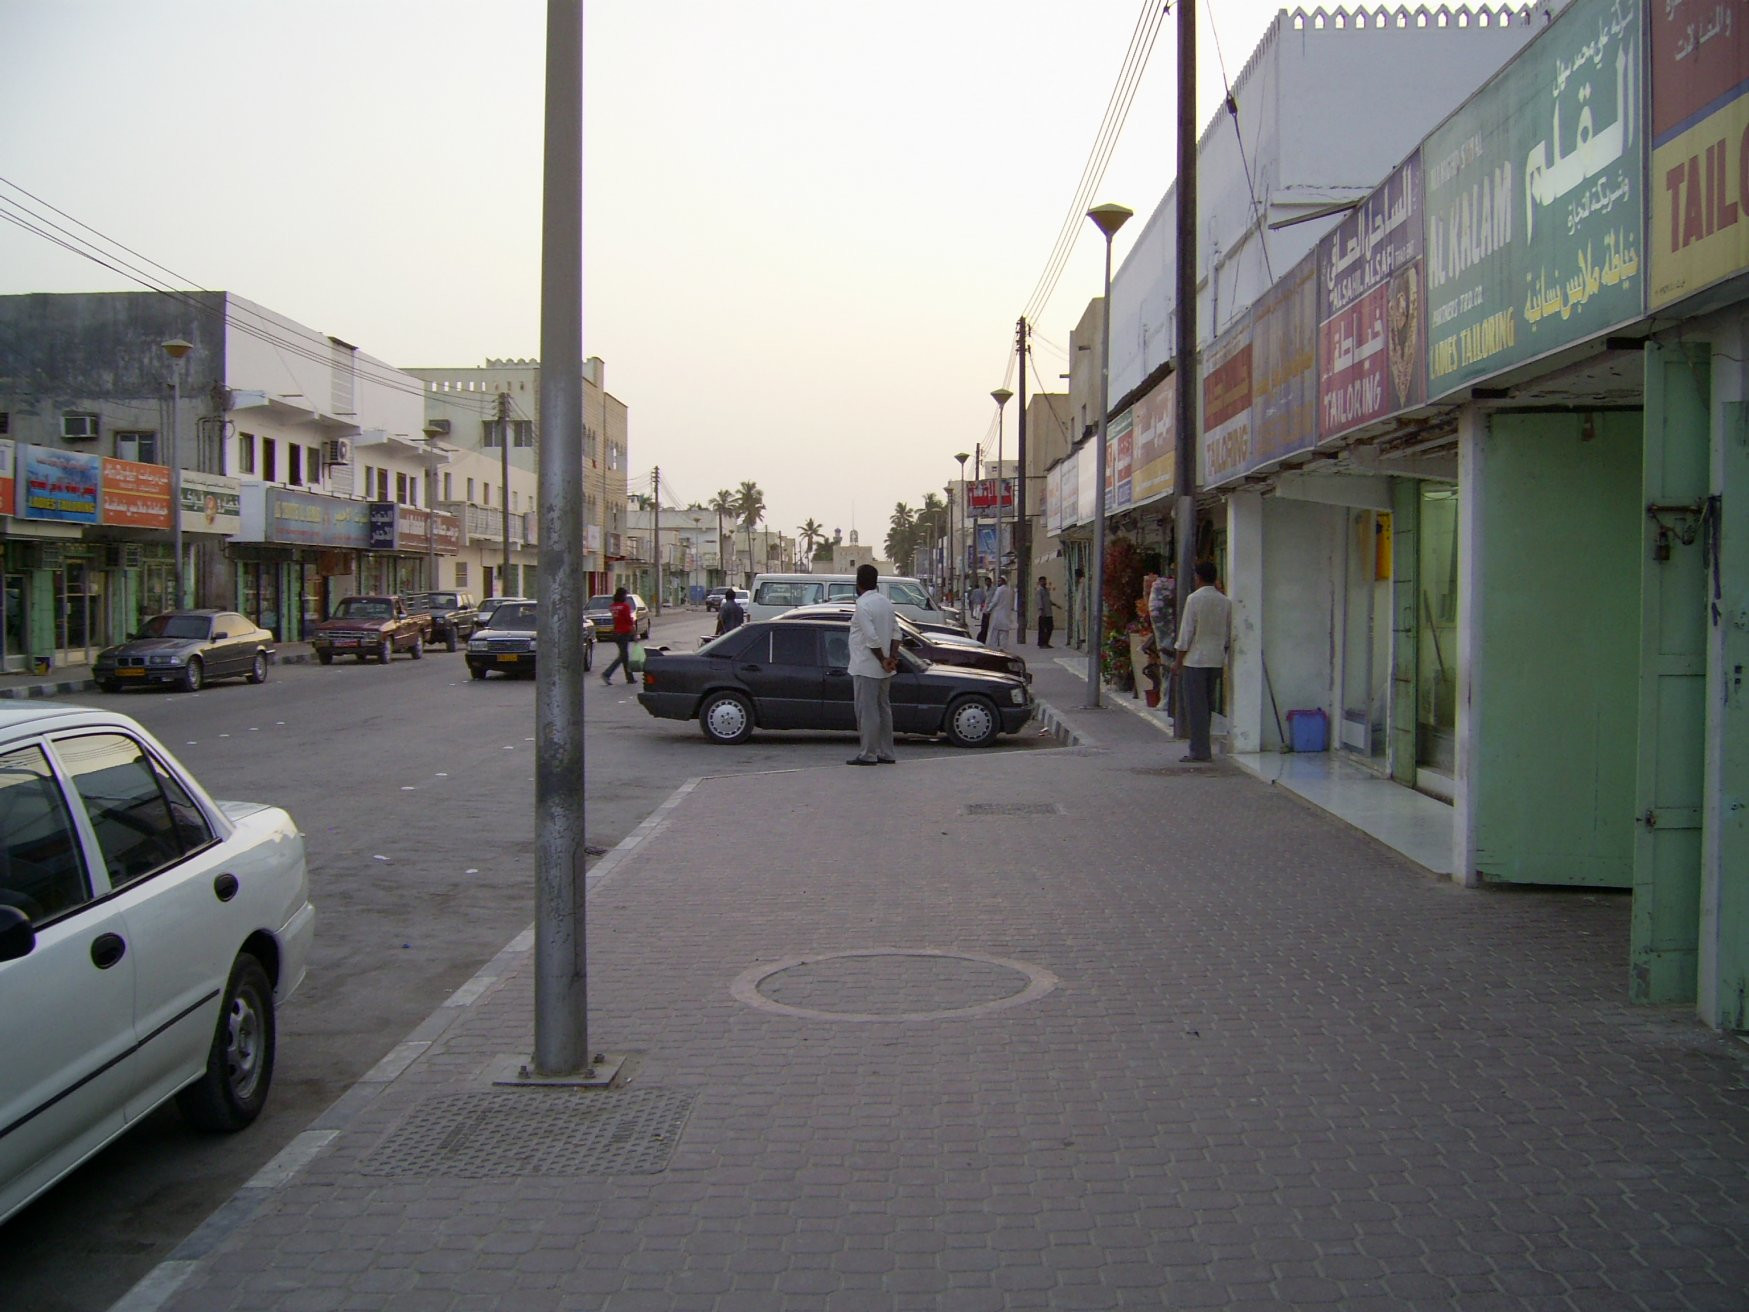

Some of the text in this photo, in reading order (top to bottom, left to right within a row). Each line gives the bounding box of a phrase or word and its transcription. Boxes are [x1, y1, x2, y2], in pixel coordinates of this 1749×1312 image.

[1525, 34, 1635, 247] القلم
[1448, 160, 1512, 281] KALAM
[1560, 238, 1600, 321] ملابس
[1601, 224, 1639, 290] خياطة
[1333, 307, 1385, 374] خياطة
[1460, 305, 1516, 367] TAILORING
[1324, 371, 1382, 430] TAILORING
